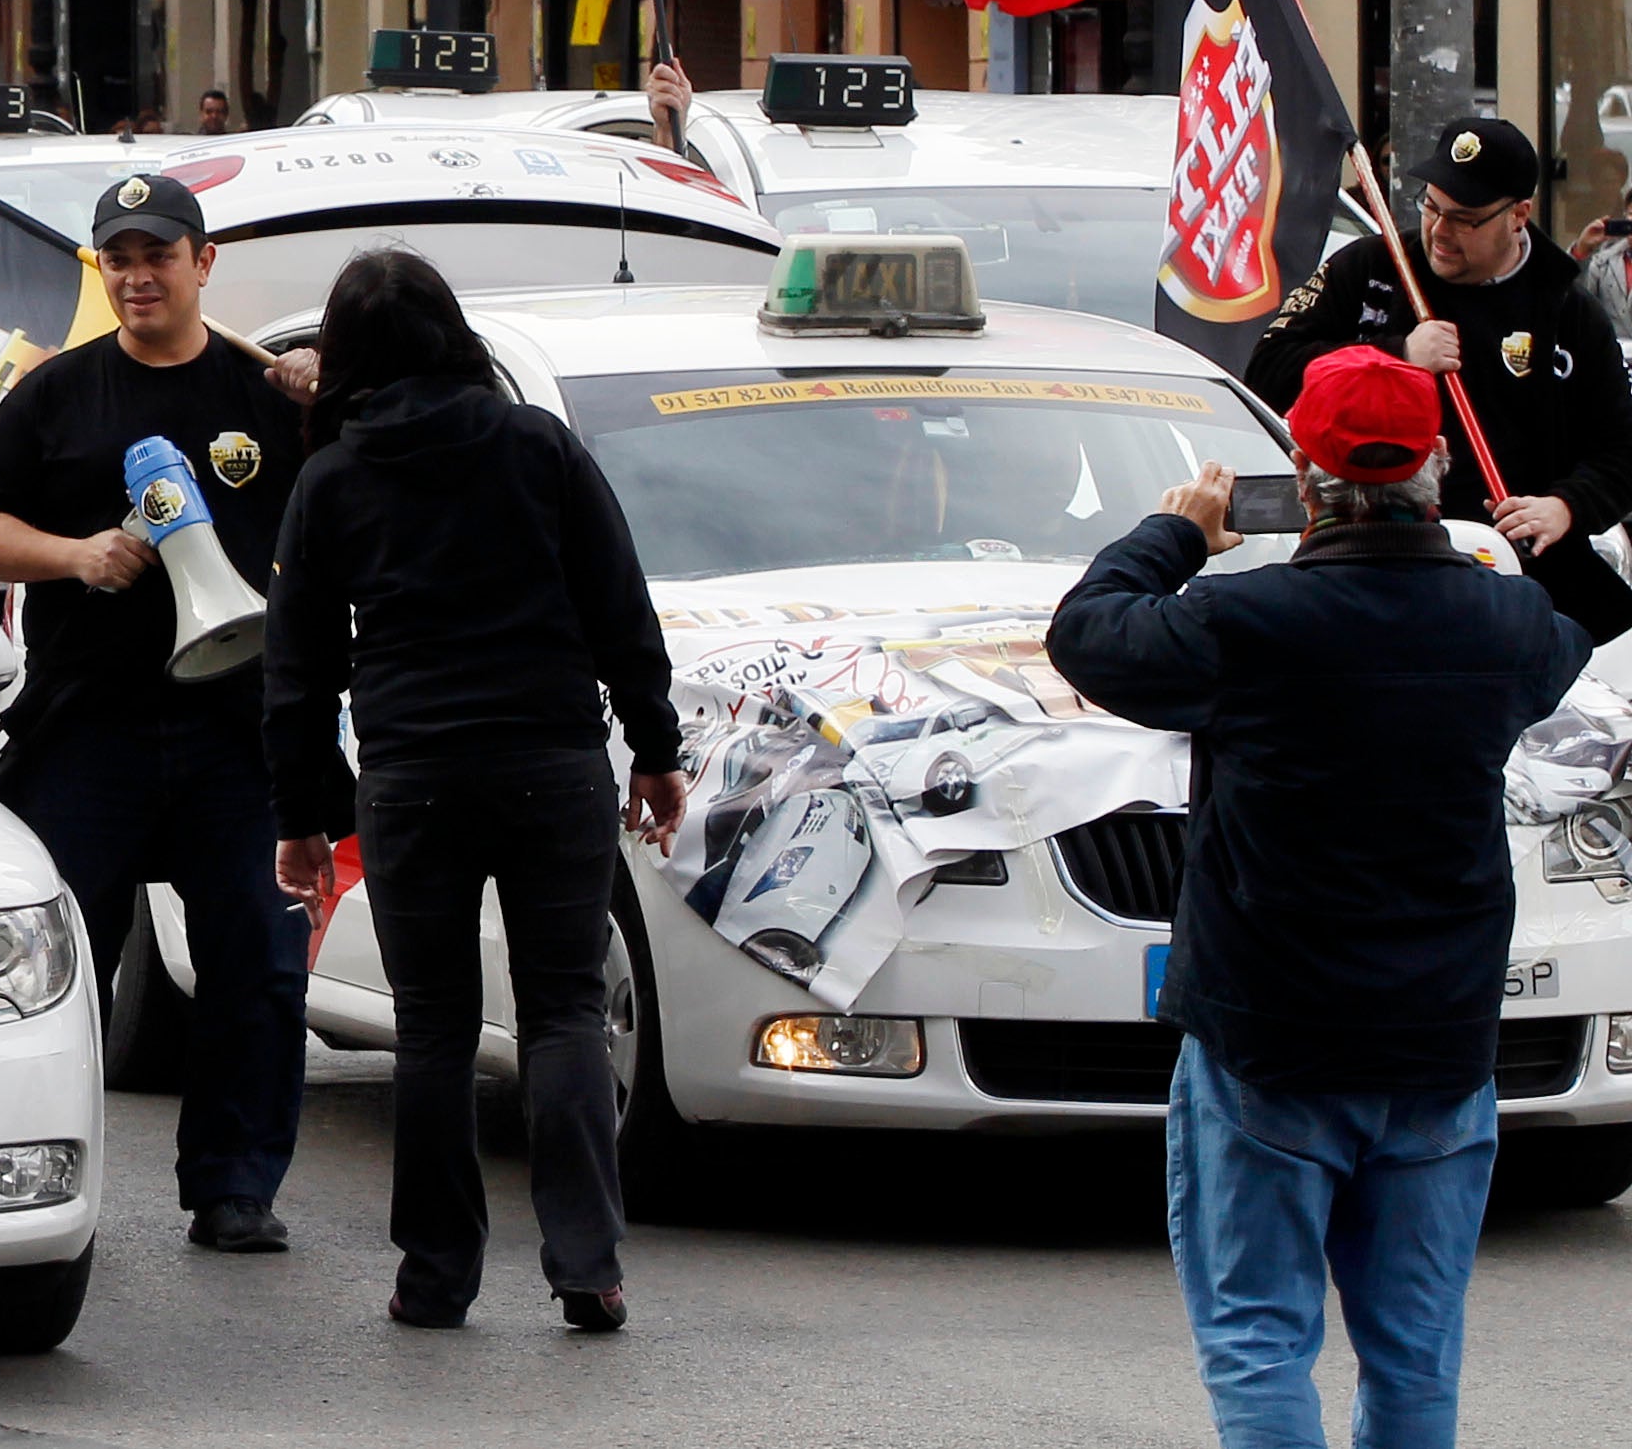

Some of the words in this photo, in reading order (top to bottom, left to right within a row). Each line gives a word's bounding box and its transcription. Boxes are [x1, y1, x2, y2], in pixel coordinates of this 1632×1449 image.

[411, 34, 490, 72] 123
[815, 67, 906, 110] 123
[275, 152, 393, 173] 08267
[660, 394, 688, 410] 91
[694, 390, 734, 408] 547
[738, 387, 767, 404] 82
[771, 385, 797, 400] 00
[841, 378, 1034, 397] Radioteléfono-Taxi
[1073, 385, 1101, 401] 91
[1105, 387, 1143, 404] 547
[1147, 390, 1178, 408] 82
[1181, 394, 1204, 411] 00
[209, 447, 262, 462] ELITE
